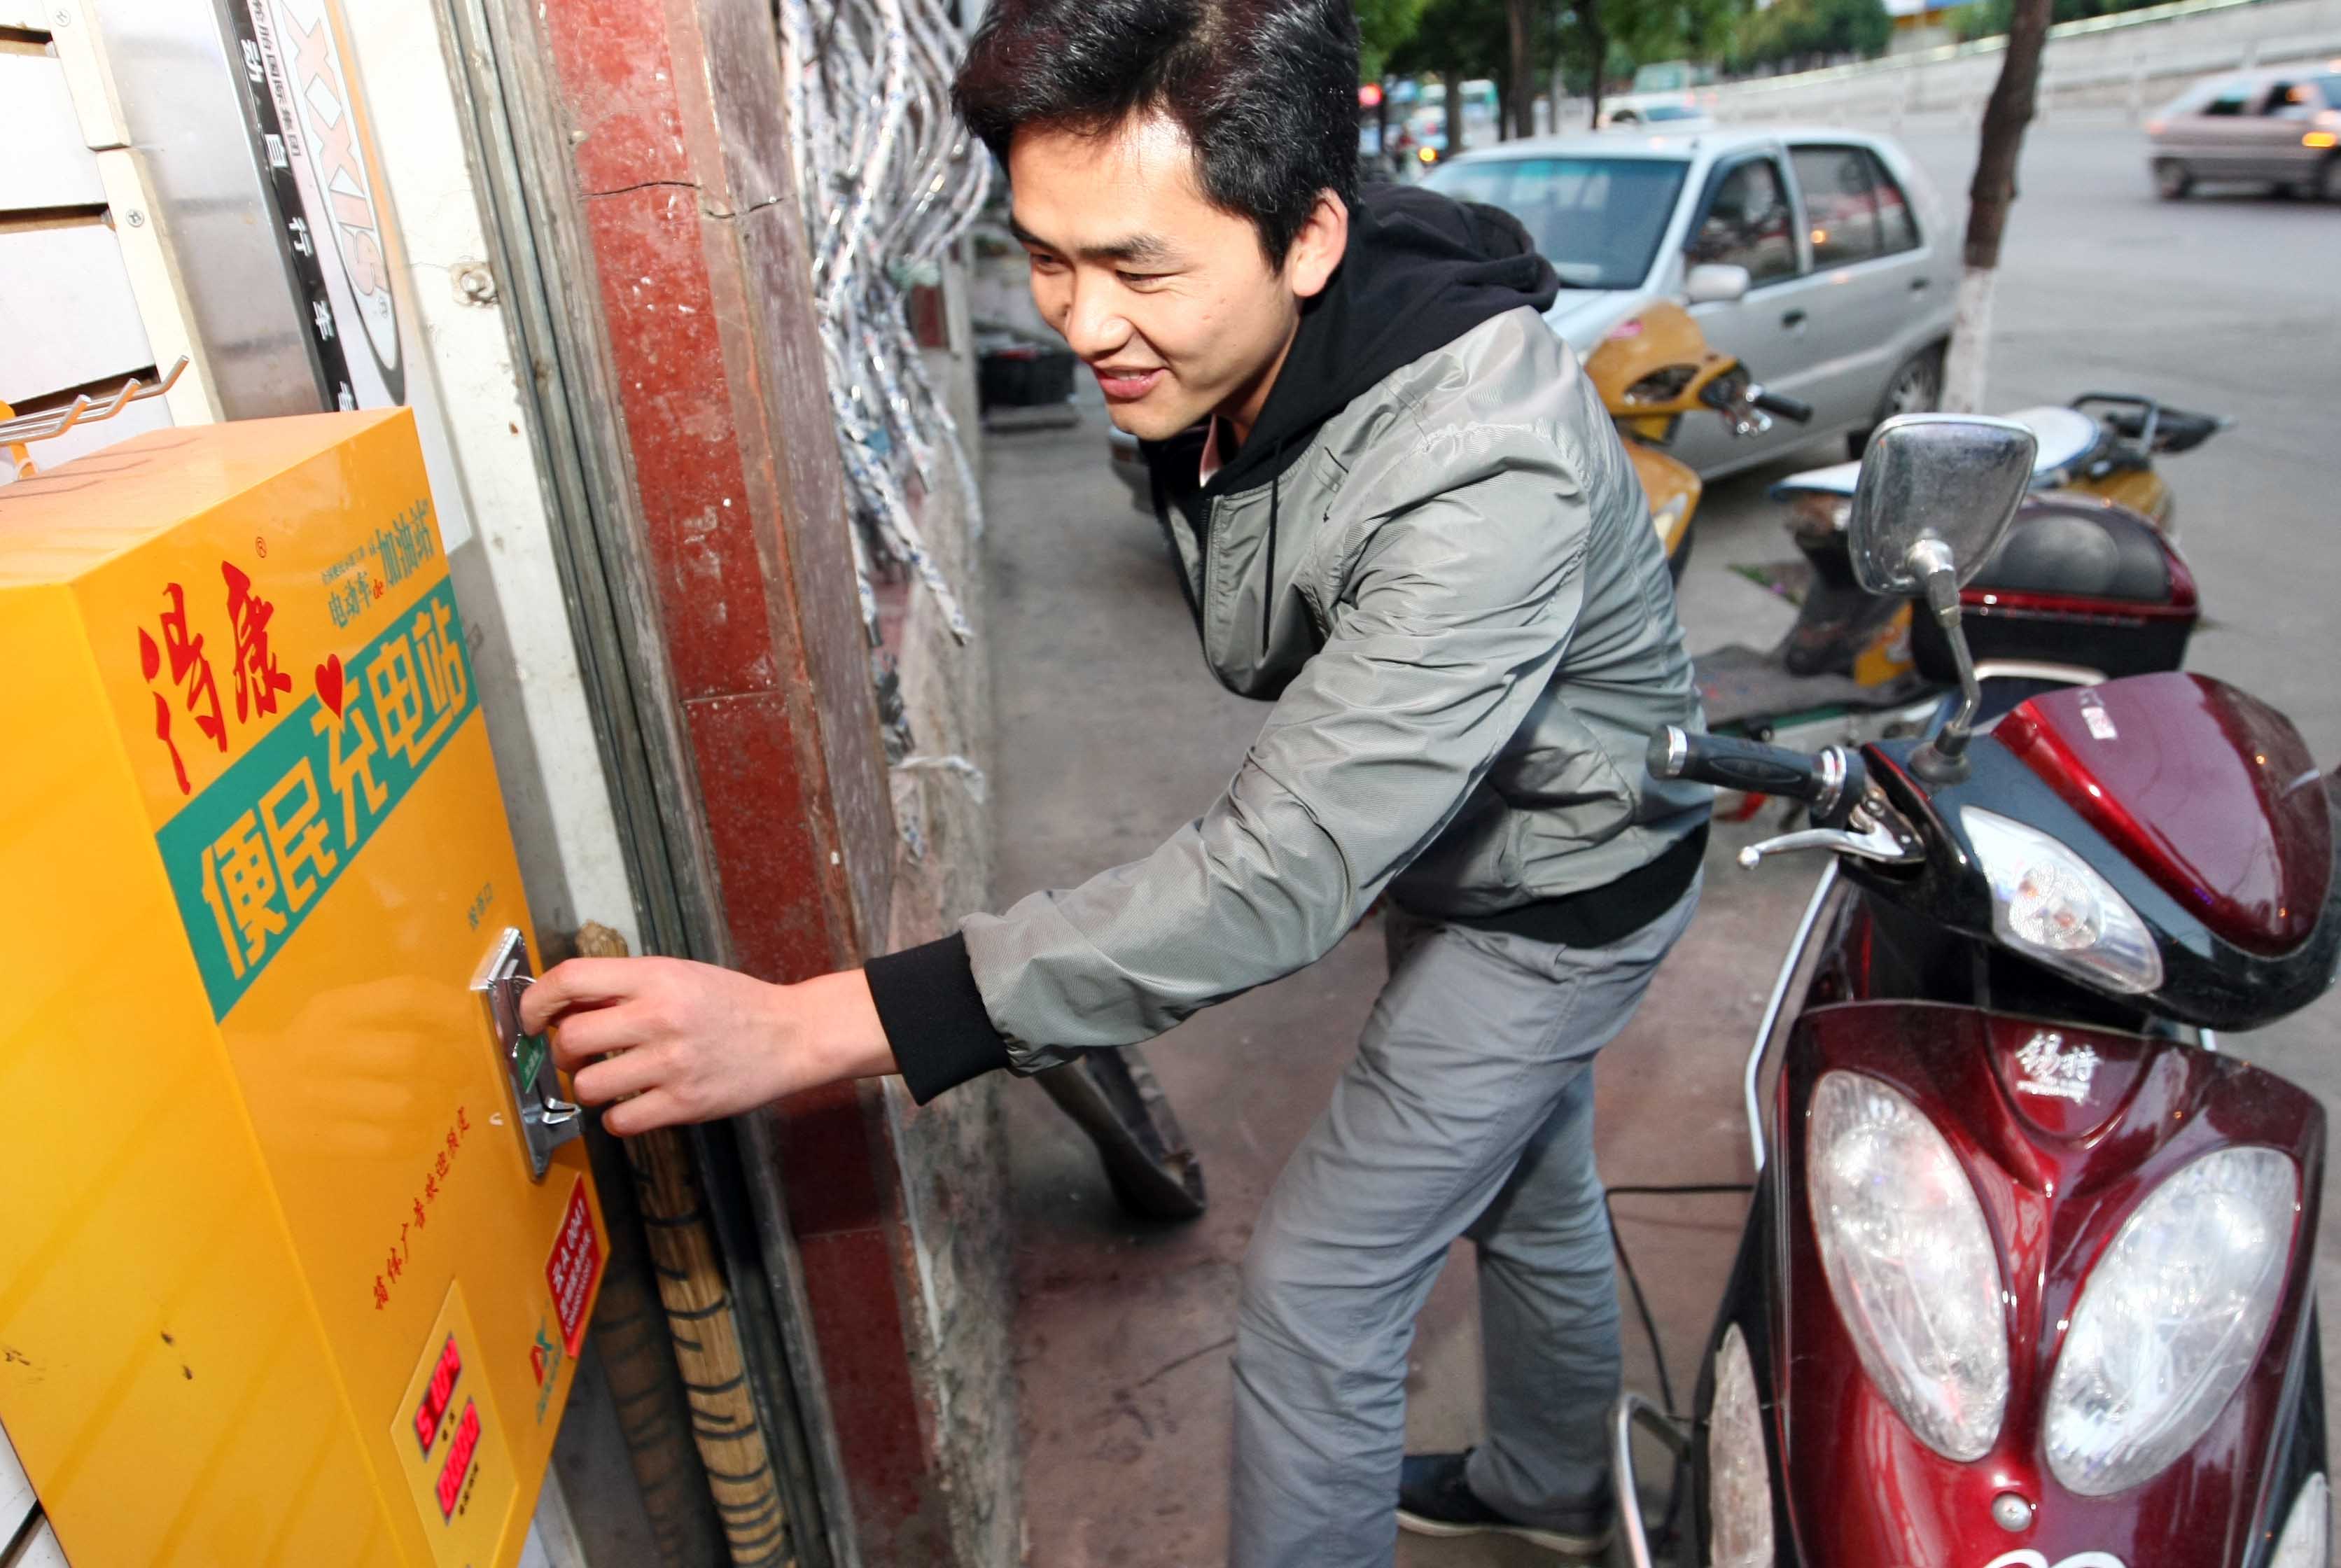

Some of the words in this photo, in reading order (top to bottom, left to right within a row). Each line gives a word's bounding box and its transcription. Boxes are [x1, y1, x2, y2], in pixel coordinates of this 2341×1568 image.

[200, 596, 468, 979] 便民充电站
